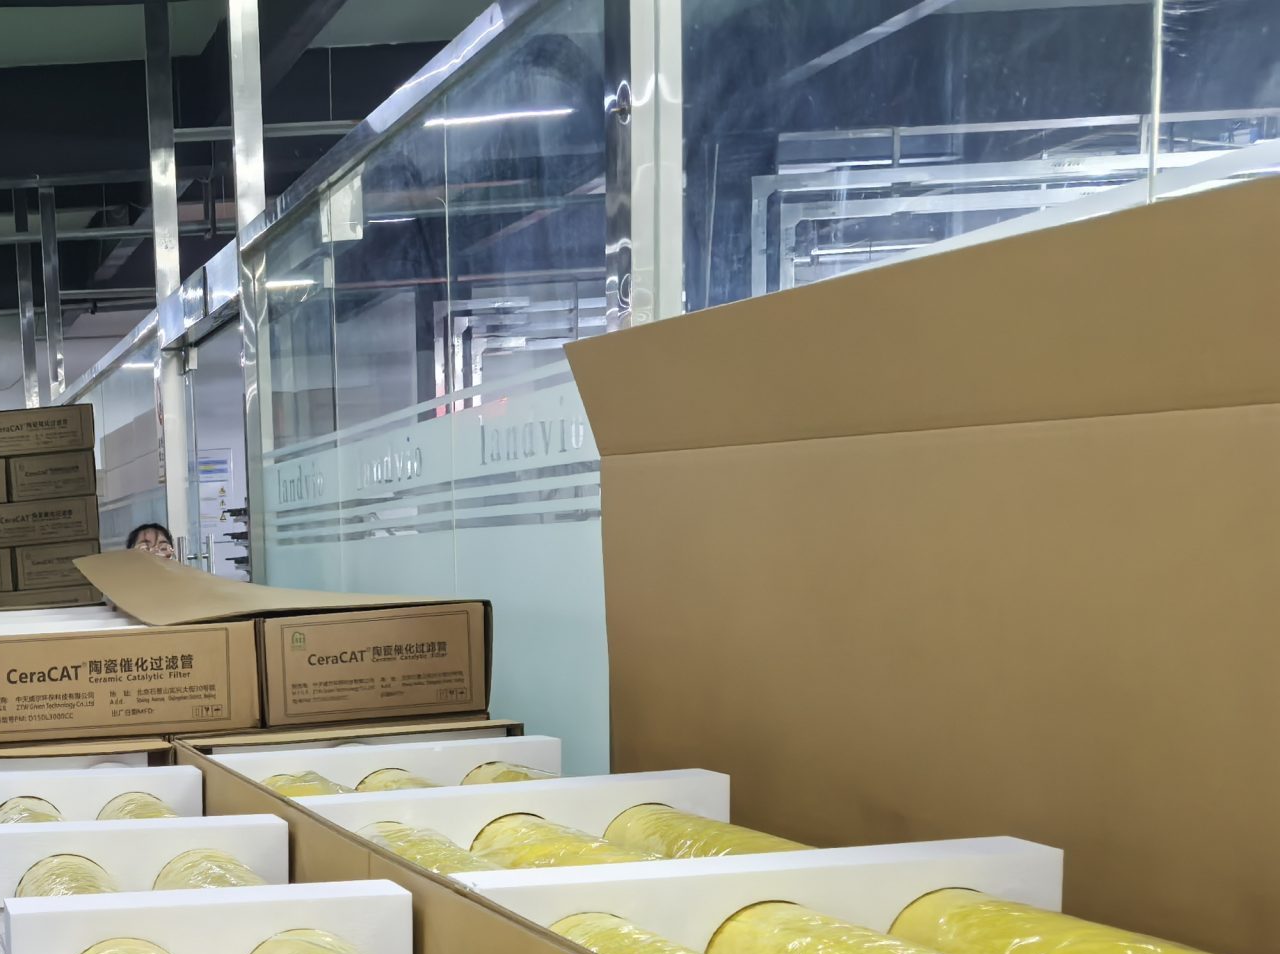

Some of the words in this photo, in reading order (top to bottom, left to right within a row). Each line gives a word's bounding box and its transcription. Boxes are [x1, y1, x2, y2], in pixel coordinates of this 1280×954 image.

[307, 650, 367, 666] CeraCAT
[6, 664, 82, 685] CeraCAT
[88, 654, 194, 675] 陶瓷催化过滤管
[88, 674, 123, 684] Ceramic
[126, 671, 164, 682] Catalytic
[168, 670, 191, 679] Filter
